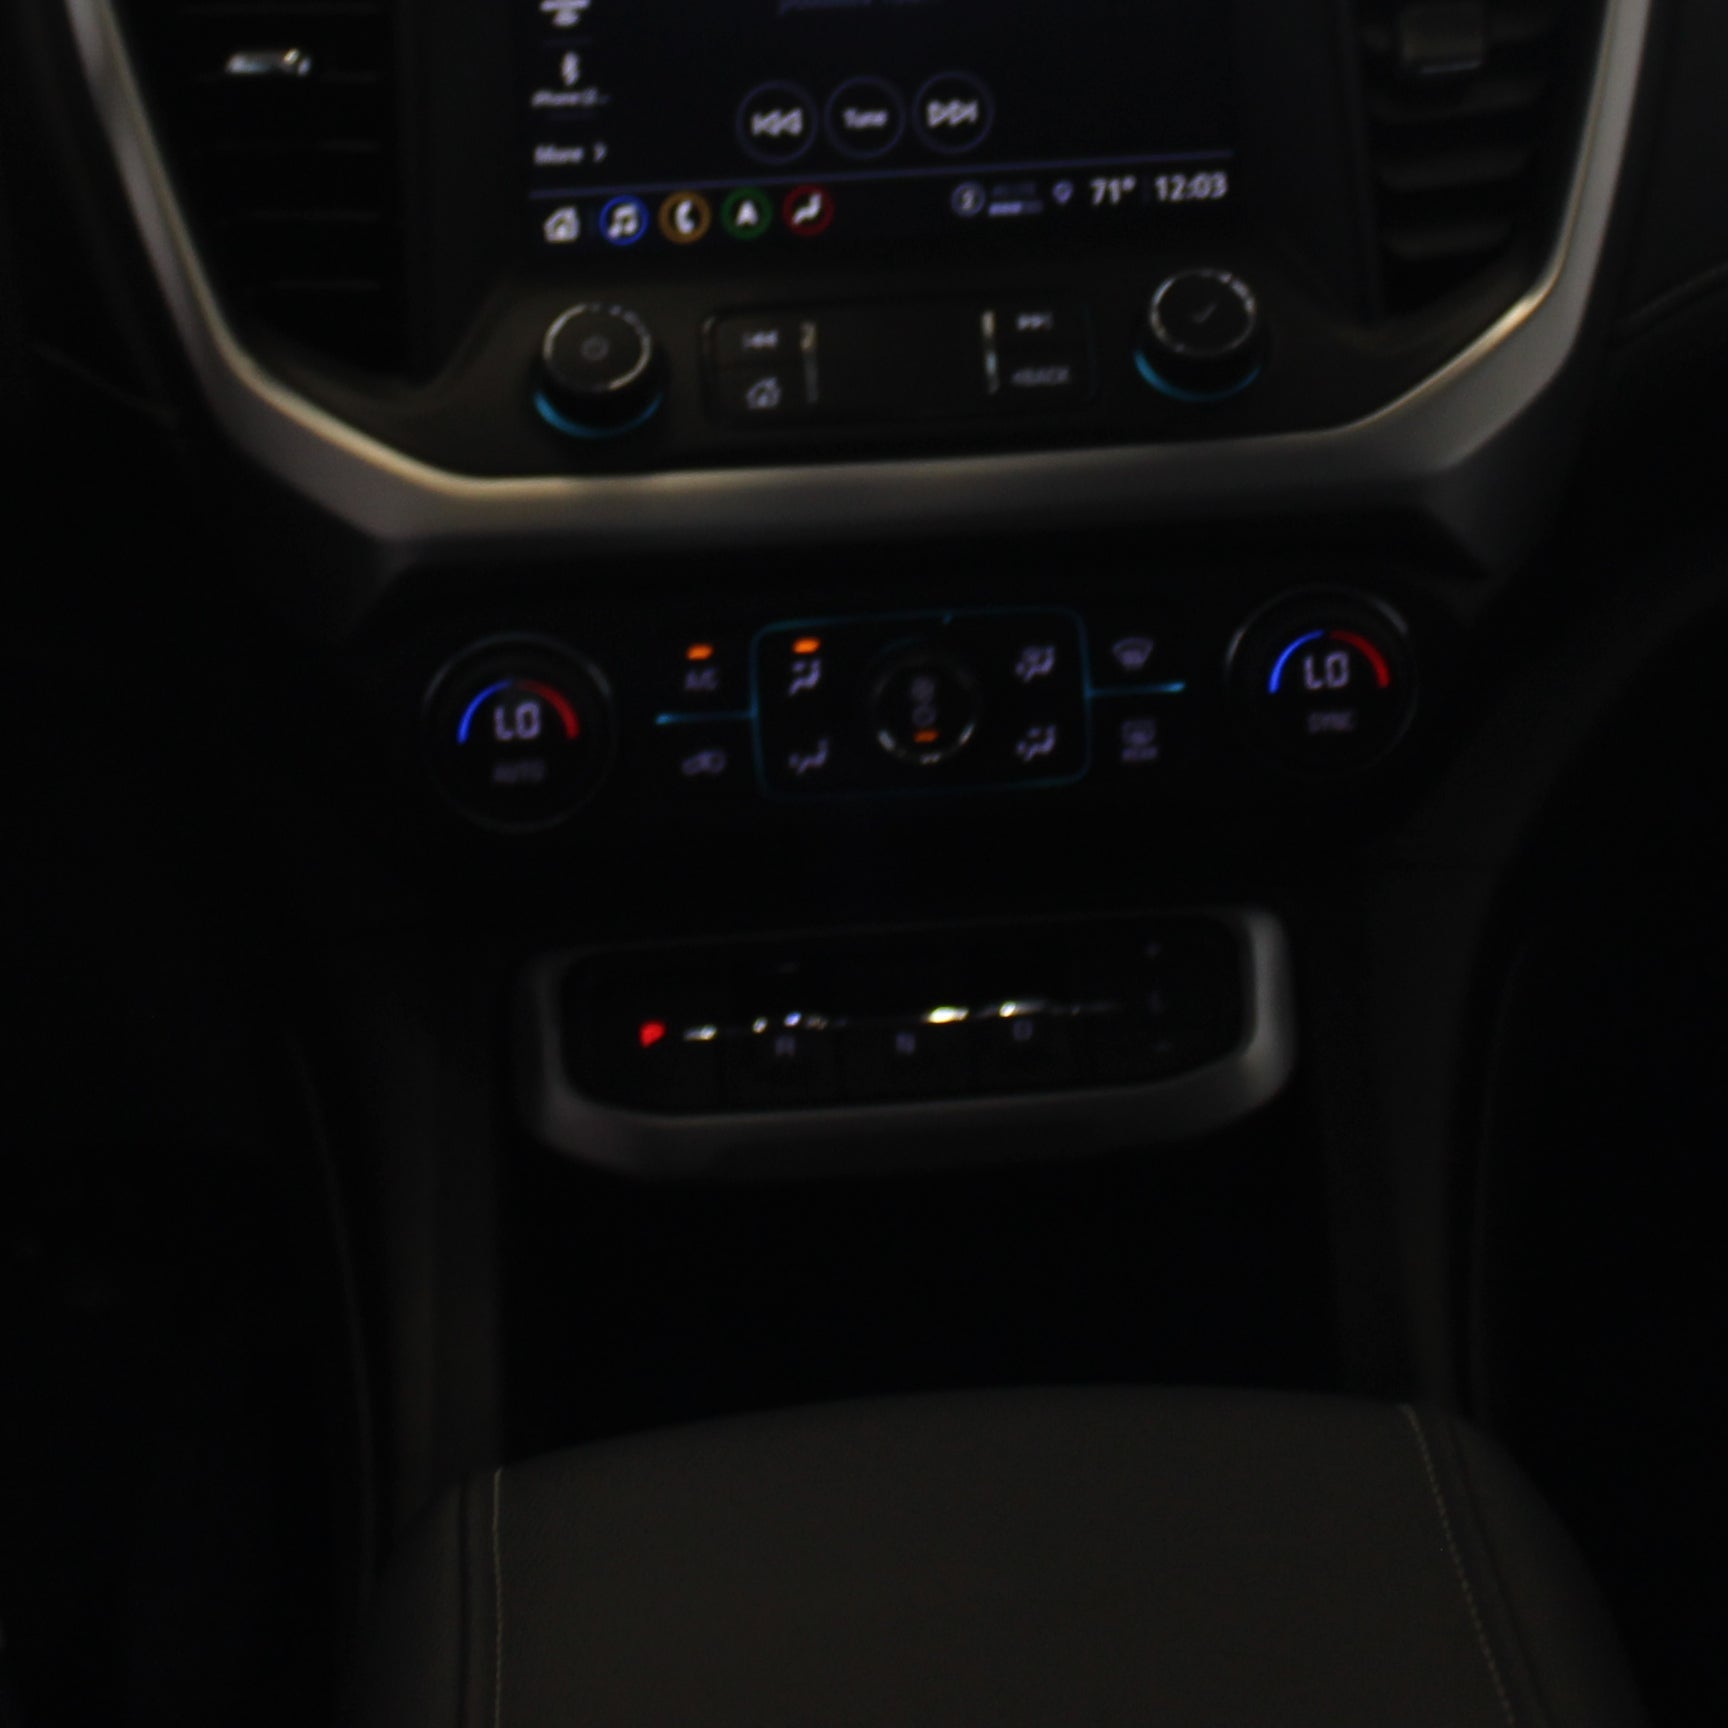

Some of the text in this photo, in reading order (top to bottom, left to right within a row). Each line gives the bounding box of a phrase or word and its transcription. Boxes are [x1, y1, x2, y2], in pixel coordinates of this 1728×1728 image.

[1154, 171, 1229, 202] 12:03
[1302, 651, 1351, 691] LO
[493, 701, 542, 741] LO
